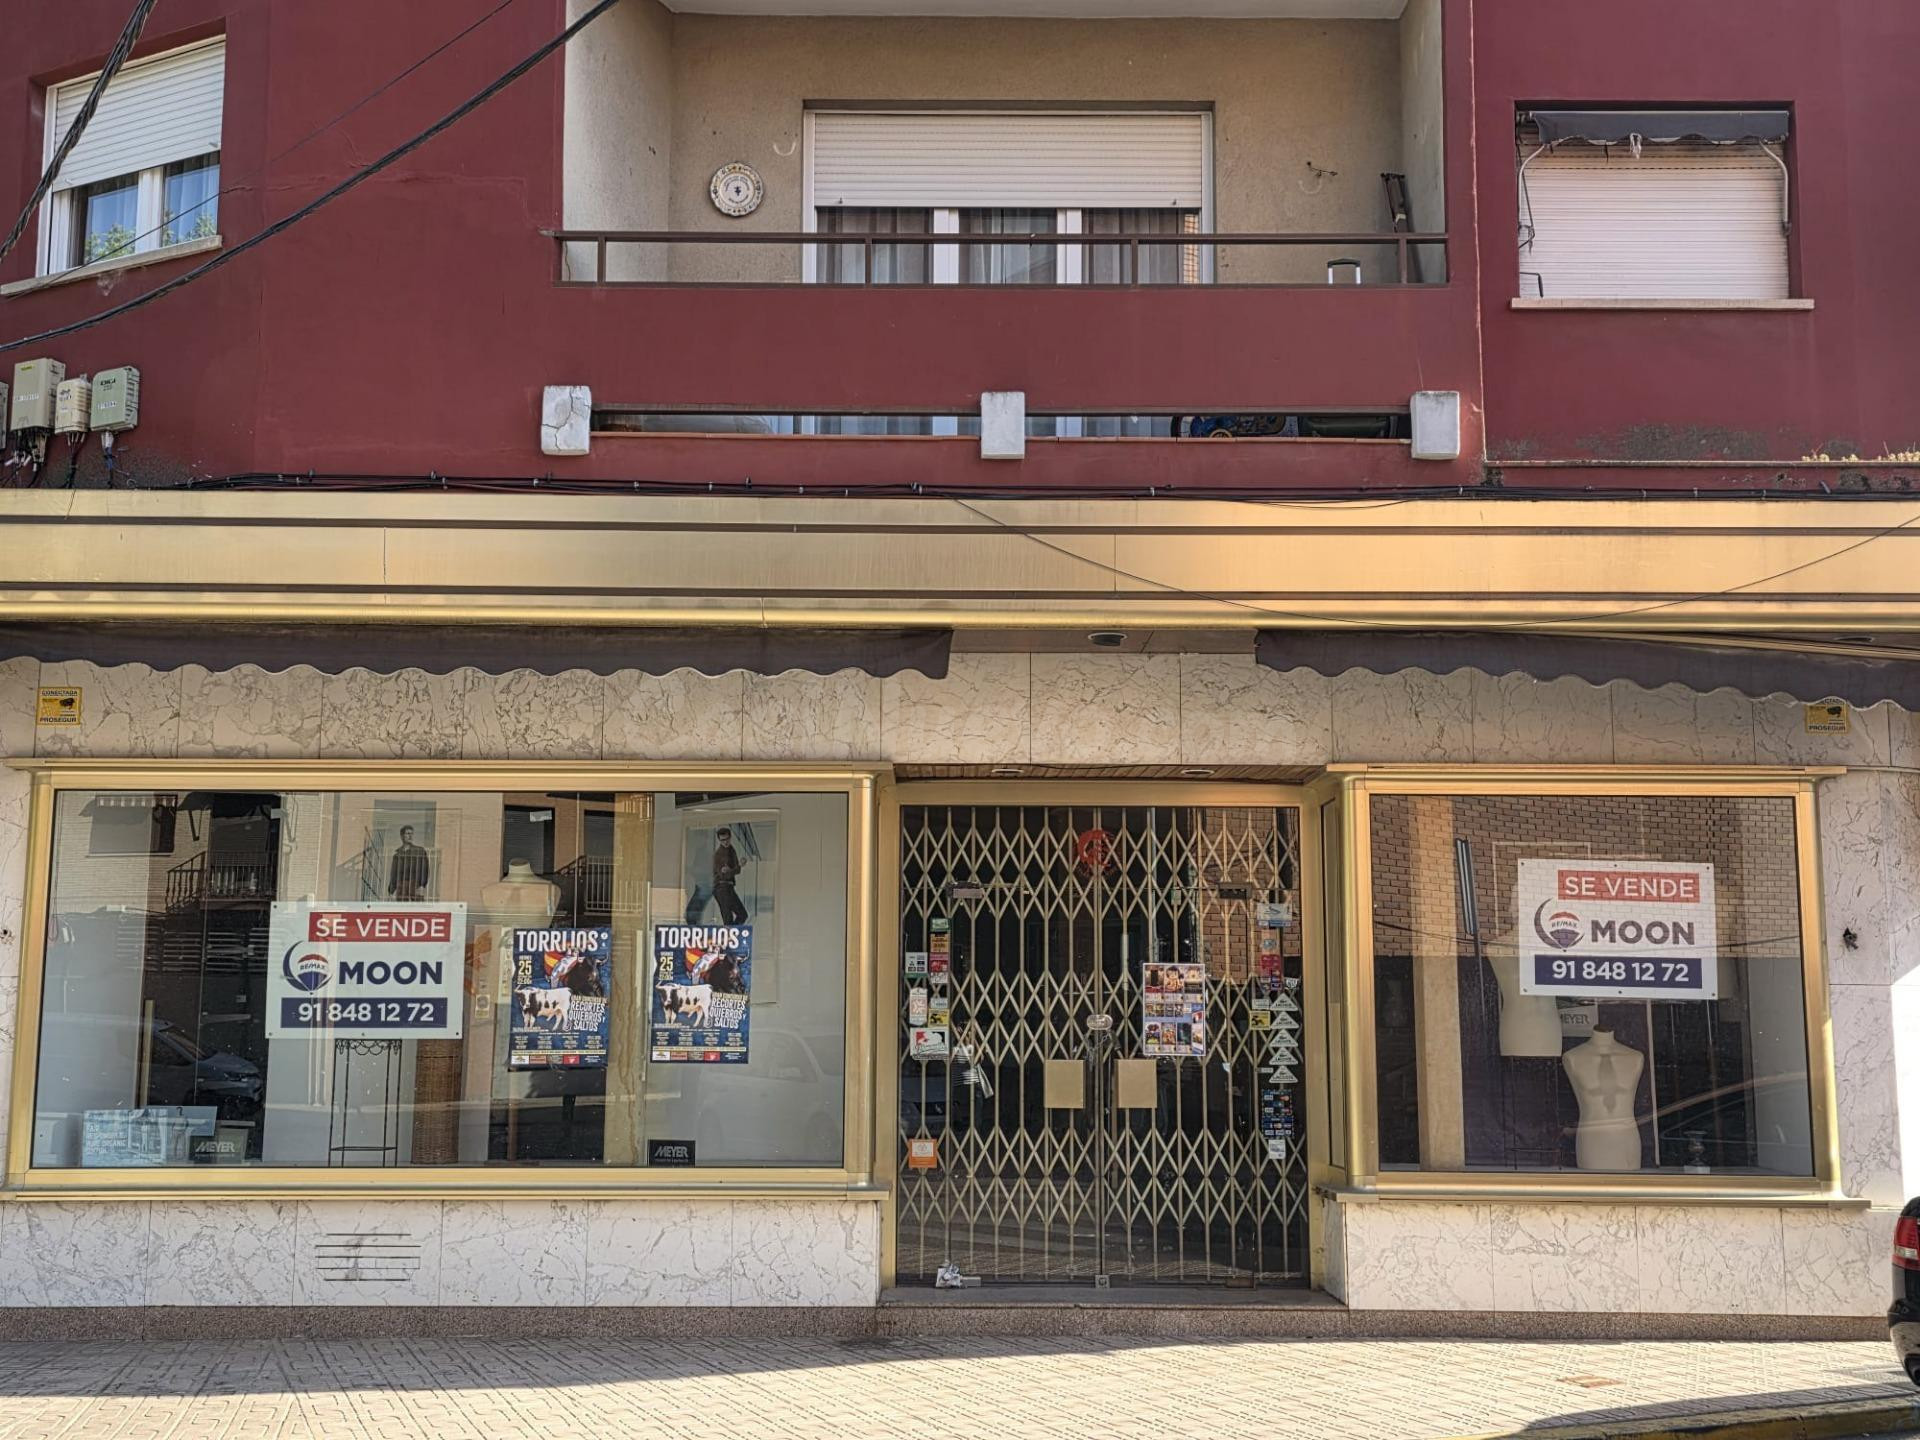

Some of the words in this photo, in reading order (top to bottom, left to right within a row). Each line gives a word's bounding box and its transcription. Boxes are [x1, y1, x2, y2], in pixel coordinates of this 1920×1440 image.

[1565, 876, 1596, 896] SE
[1604, 877, 1694, 898] VENDE
[316, 918, 347, 937] SE
[356, 918, 446, 937] VENDE
[1551, 920, 1577, 929] RE/MAX
[1591, 919, 1695, 945] MOON
[516, 930, 599, 953] TORRIJOS
[658, 927, 740, 950] TORRIJOS
[299, 963, 326, 971] RE/MAX
[518, 960, 532, 975] 25
[659, 956, 674, 971] 25
[1552, 960, 1576, 979] 91
[1582, 961, 1626, 981] 848
[1631, 962, 1655, 981] 12
[1662, 963, 1689, 982] 72
[339, 961, 443, 985] MOON
[298, 1003, 322, 1021] 91
[328, 1003, 372, 1022] 848
[377, 1003, 400, 1021] 12
[407, 1003, 434, 1022] 72
[569, 1010, 602, 1023] QUIEBROS
[709, 1007, 742, 1020] QUIEBROS
[1560, 1013, 1590, 1024] EYER
[573, 1020, 599, 1031] SALTOS
[714, 1018, 739, 1029] SALTOS
[195, 1141, 235, 1153] MEYER
[654, 1145, 689, 1158] MEYER
